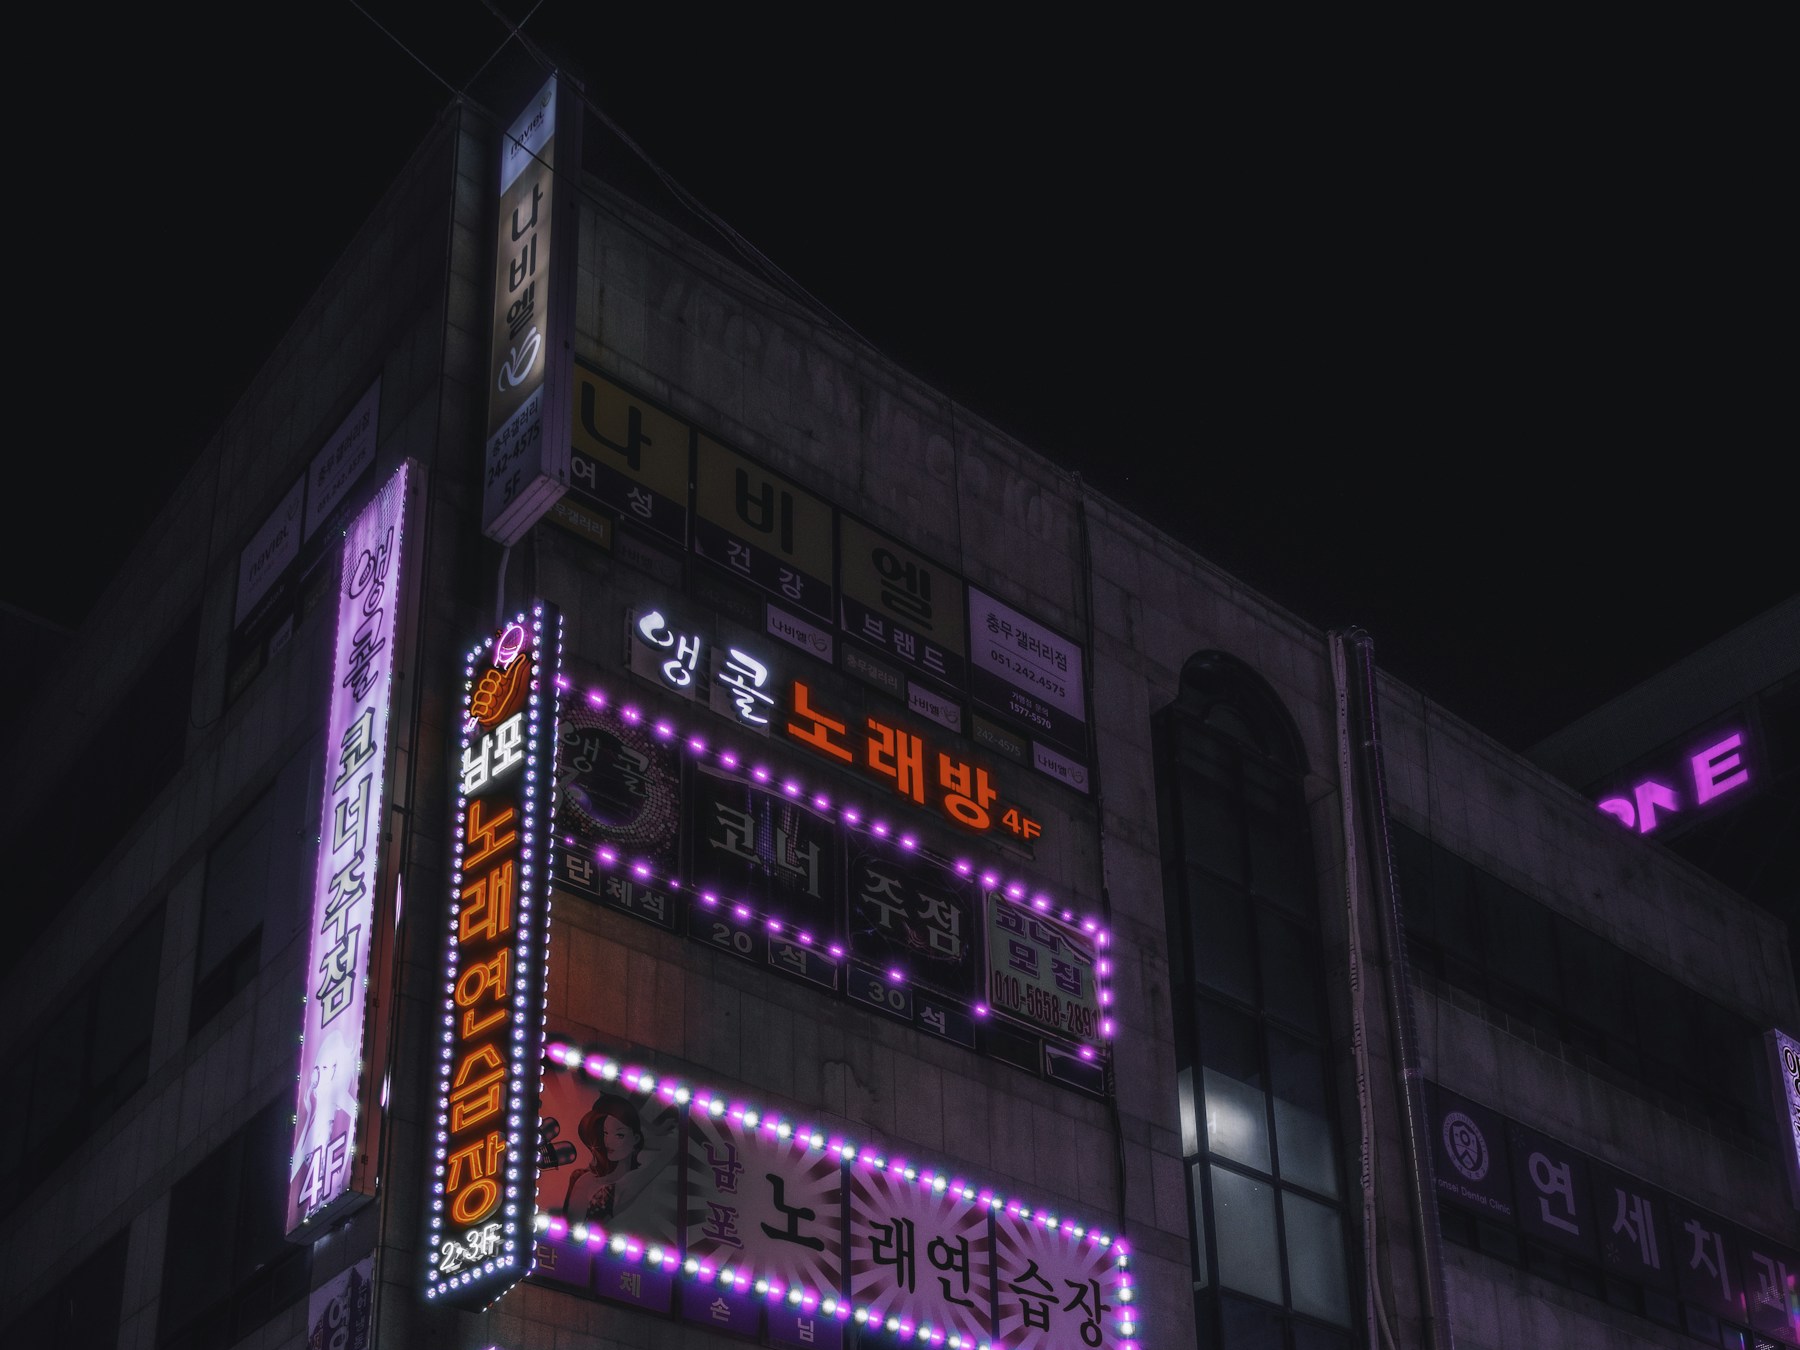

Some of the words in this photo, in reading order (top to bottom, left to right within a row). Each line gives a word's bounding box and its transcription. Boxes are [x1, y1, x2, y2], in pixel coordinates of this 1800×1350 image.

[506, 183, 543, 339] 나비엘
[488, 420, 541, 487] 242-4575
[503, 468, 521, 504] 5F
[571, 456, 653, 519] 여성
[727, 539, 804, 600] 건강
[771, 615, 807, 644] 나비엘
[862, 612, 946, 674] 브랜드
[990, 650, 1066, 698] 051.242.4575
[462, 711, 528, 798] 남포
[637, 608, 774, 726] 앵콜
[786, 680, 998, 831] 노래방
[1001, 807, 1043, 840] 4F
[1037, 753, 1068, 777] 나비엘
[861, 865, 967, 957] 주점
[1009, 939, 1083, 998] 모집
[446, 799, 520, 1226] 노래연습장
[298, 1131, 348, 1212] 4F
[703, 1141, 745, 1250] 남포
[760, 1172, 1111, 1350] 노래연습장
